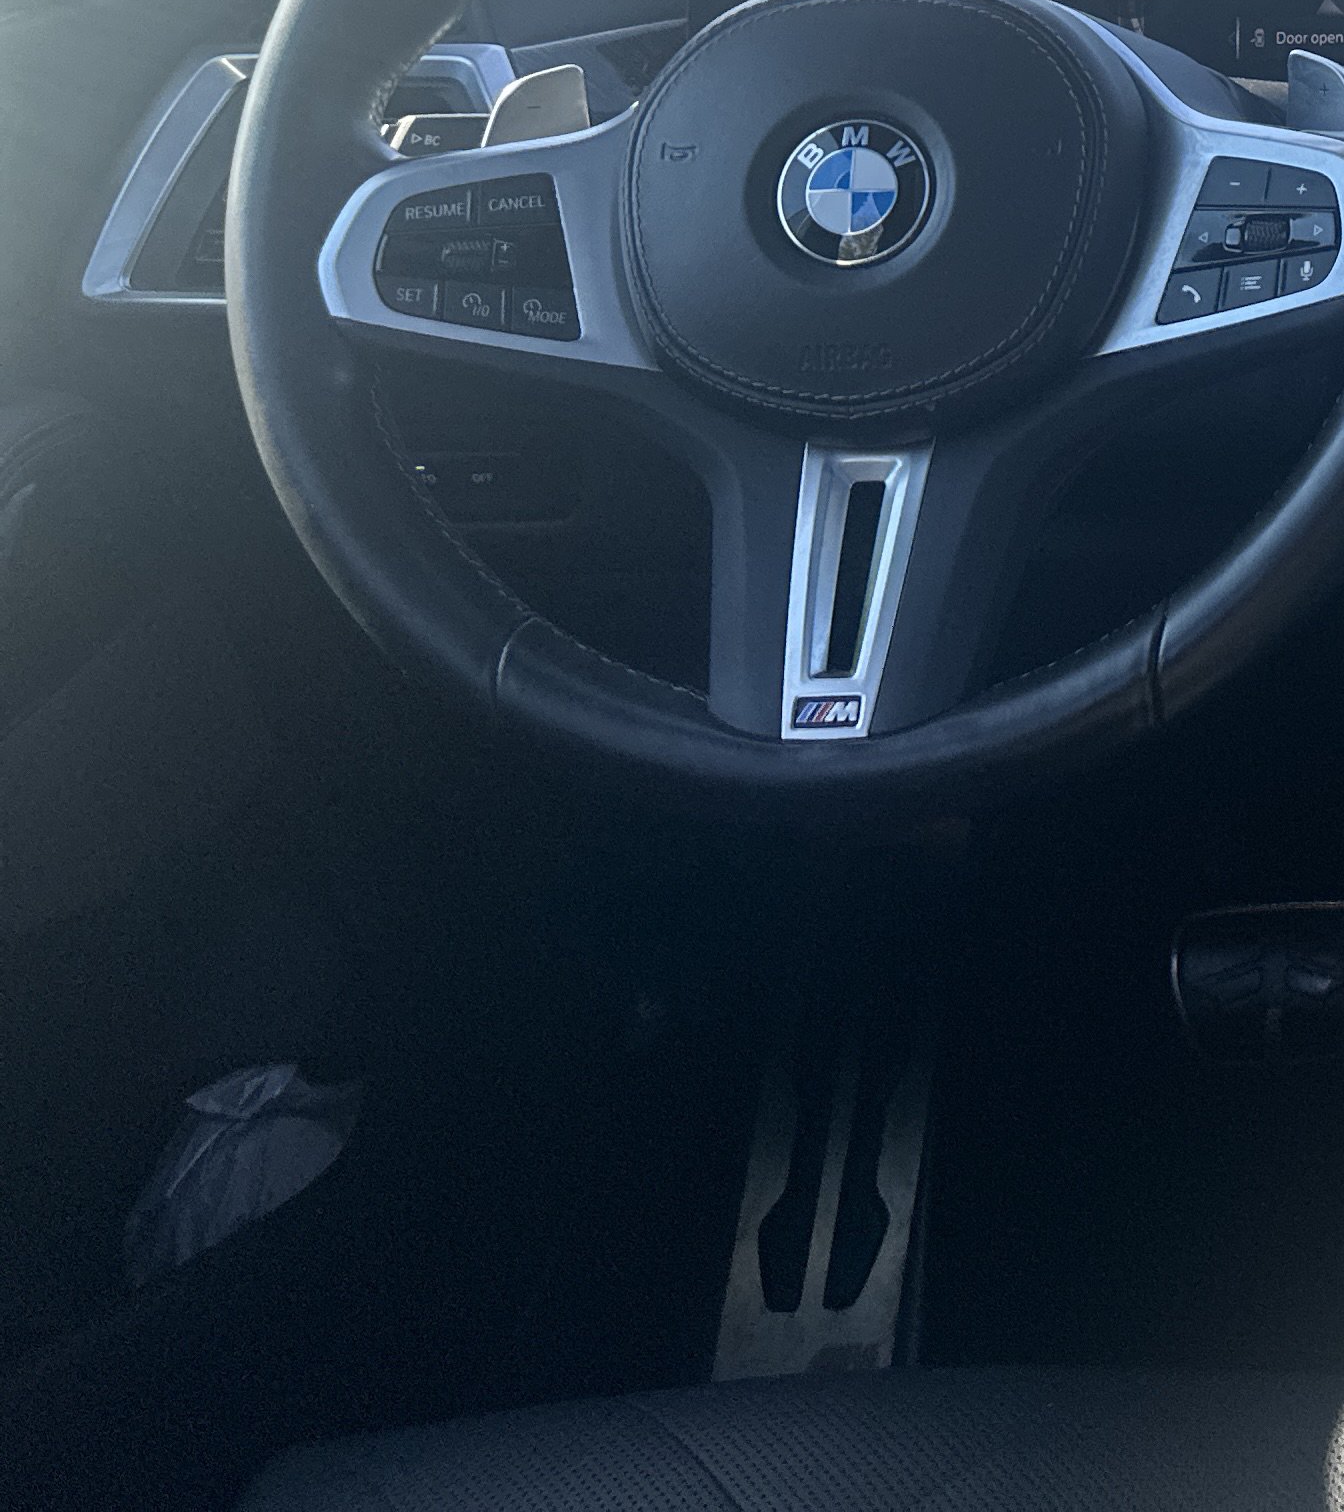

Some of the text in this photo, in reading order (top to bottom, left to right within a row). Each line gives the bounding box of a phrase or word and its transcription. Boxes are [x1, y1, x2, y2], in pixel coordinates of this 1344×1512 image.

[1275, 31, 1308, 45] Door
[424, 134, 441, 146] BC
[797, 125, 916, 170] BMW
[405, 195, 546, 221] RESUME CANCEL
[396, 287, 424, 303] SET
[527, 309, 567, 325] MODE
